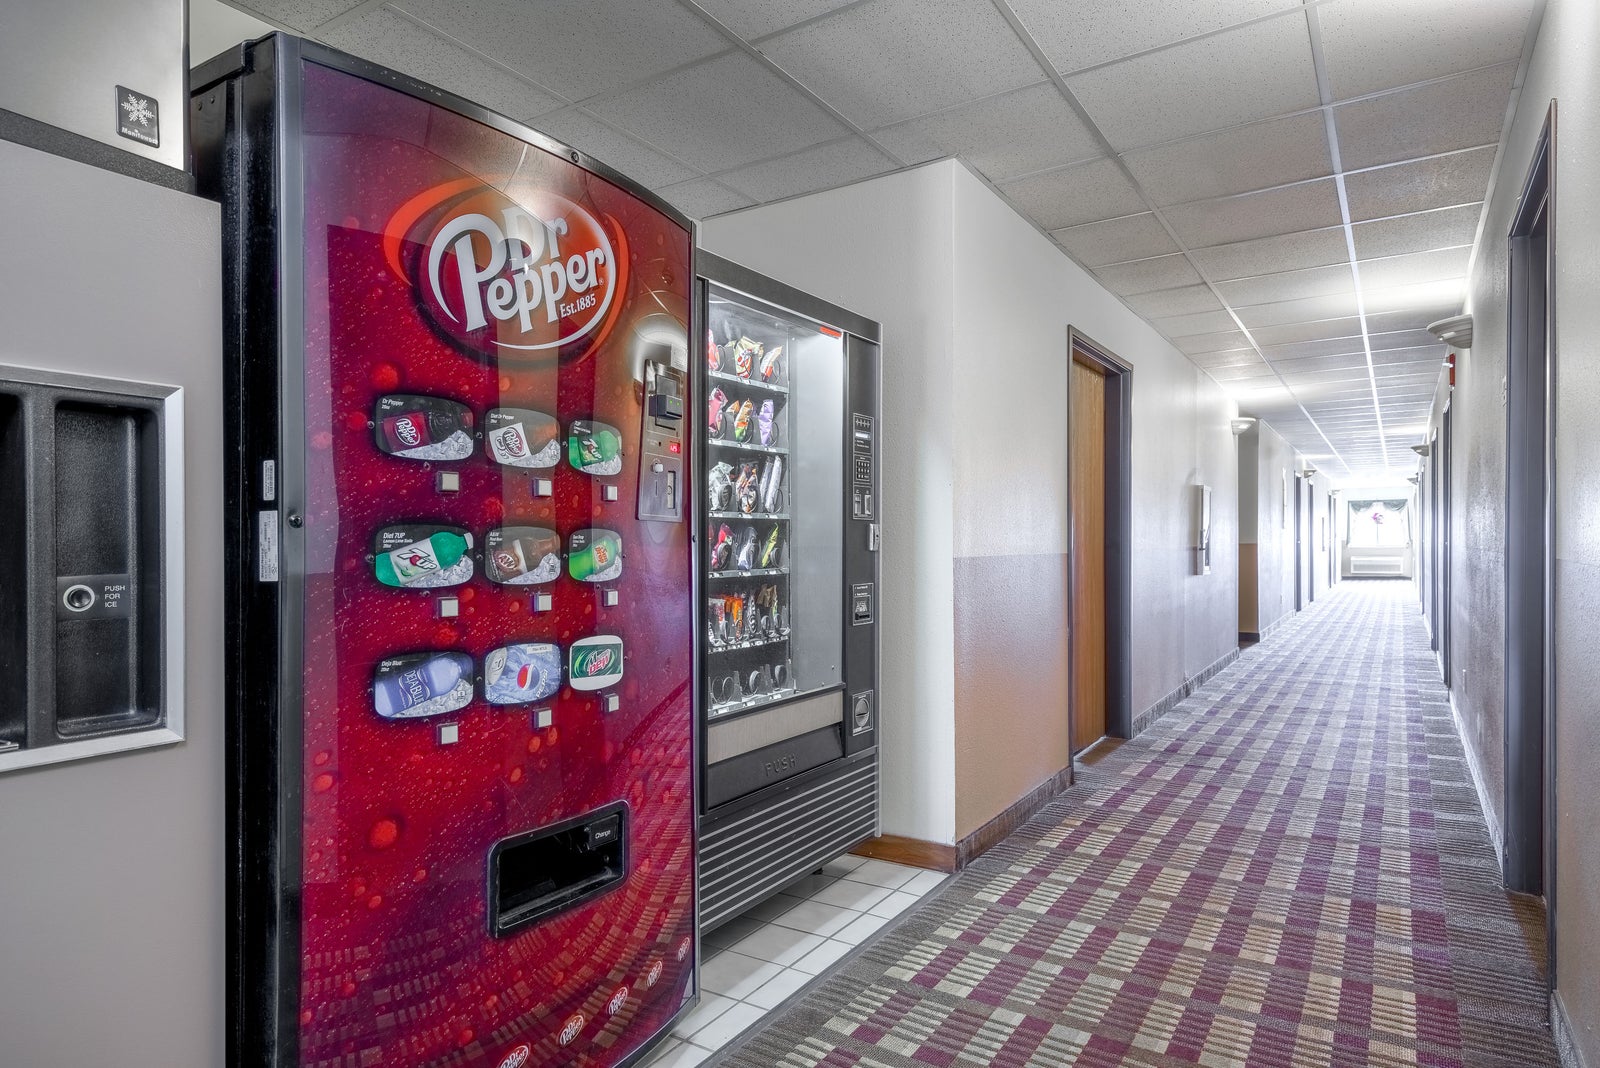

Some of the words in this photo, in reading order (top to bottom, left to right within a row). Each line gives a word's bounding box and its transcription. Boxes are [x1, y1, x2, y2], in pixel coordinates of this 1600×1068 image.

[501, 206, 568, 271] Dr
[429, 213, 606, 333] Pepper
[764, 753, 798, 777] PUSH
